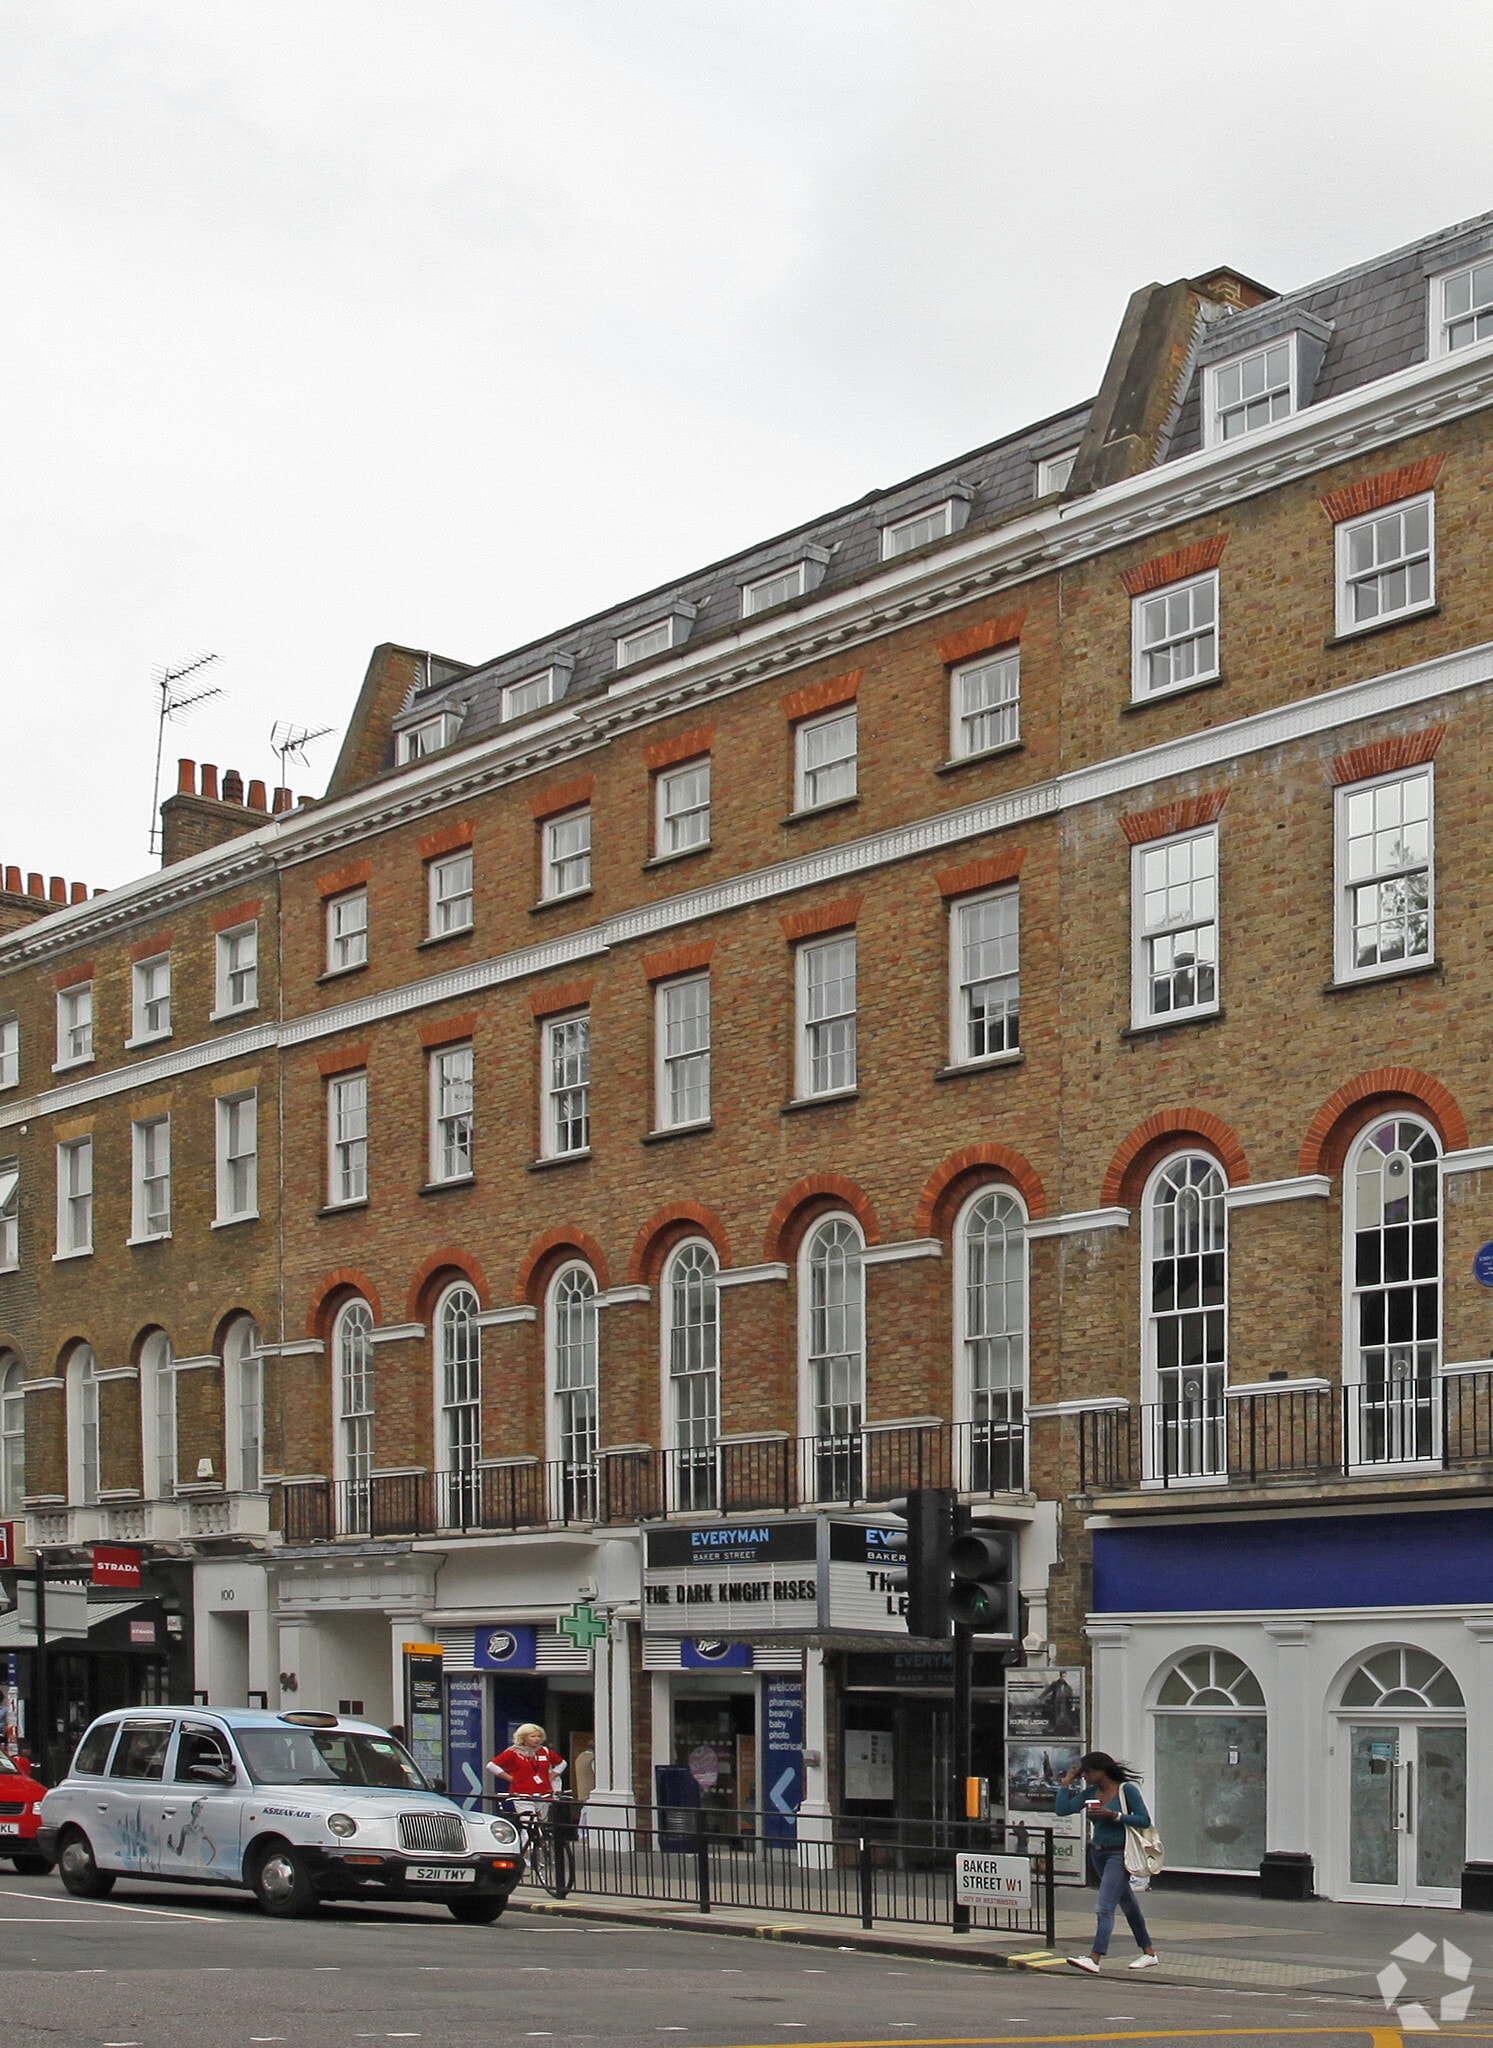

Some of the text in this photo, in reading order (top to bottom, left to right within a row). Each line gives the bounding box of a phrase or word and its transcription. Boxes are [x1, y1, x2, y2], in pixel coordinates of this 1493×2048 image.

[691, 1528, 769, 1546] EVERYMAN
[693, 1551, 756, 1561] BAKER STREET
[867, 1551, 907, 1562] BAKER
[97, 1562, 139, 1572] STRADA
[220, 1590, 234, 1600] 100
[645, 1580, 816, 1604] THE DARK KNIGHT RISES
[262, 1807, 311, 1819] KOREAN AIR
[963, 1860, 997, 1874] BAKER
[417, 1868, 466, 1880] S211 TMY
[963, 1875, 1022, 1891] STREET W1
